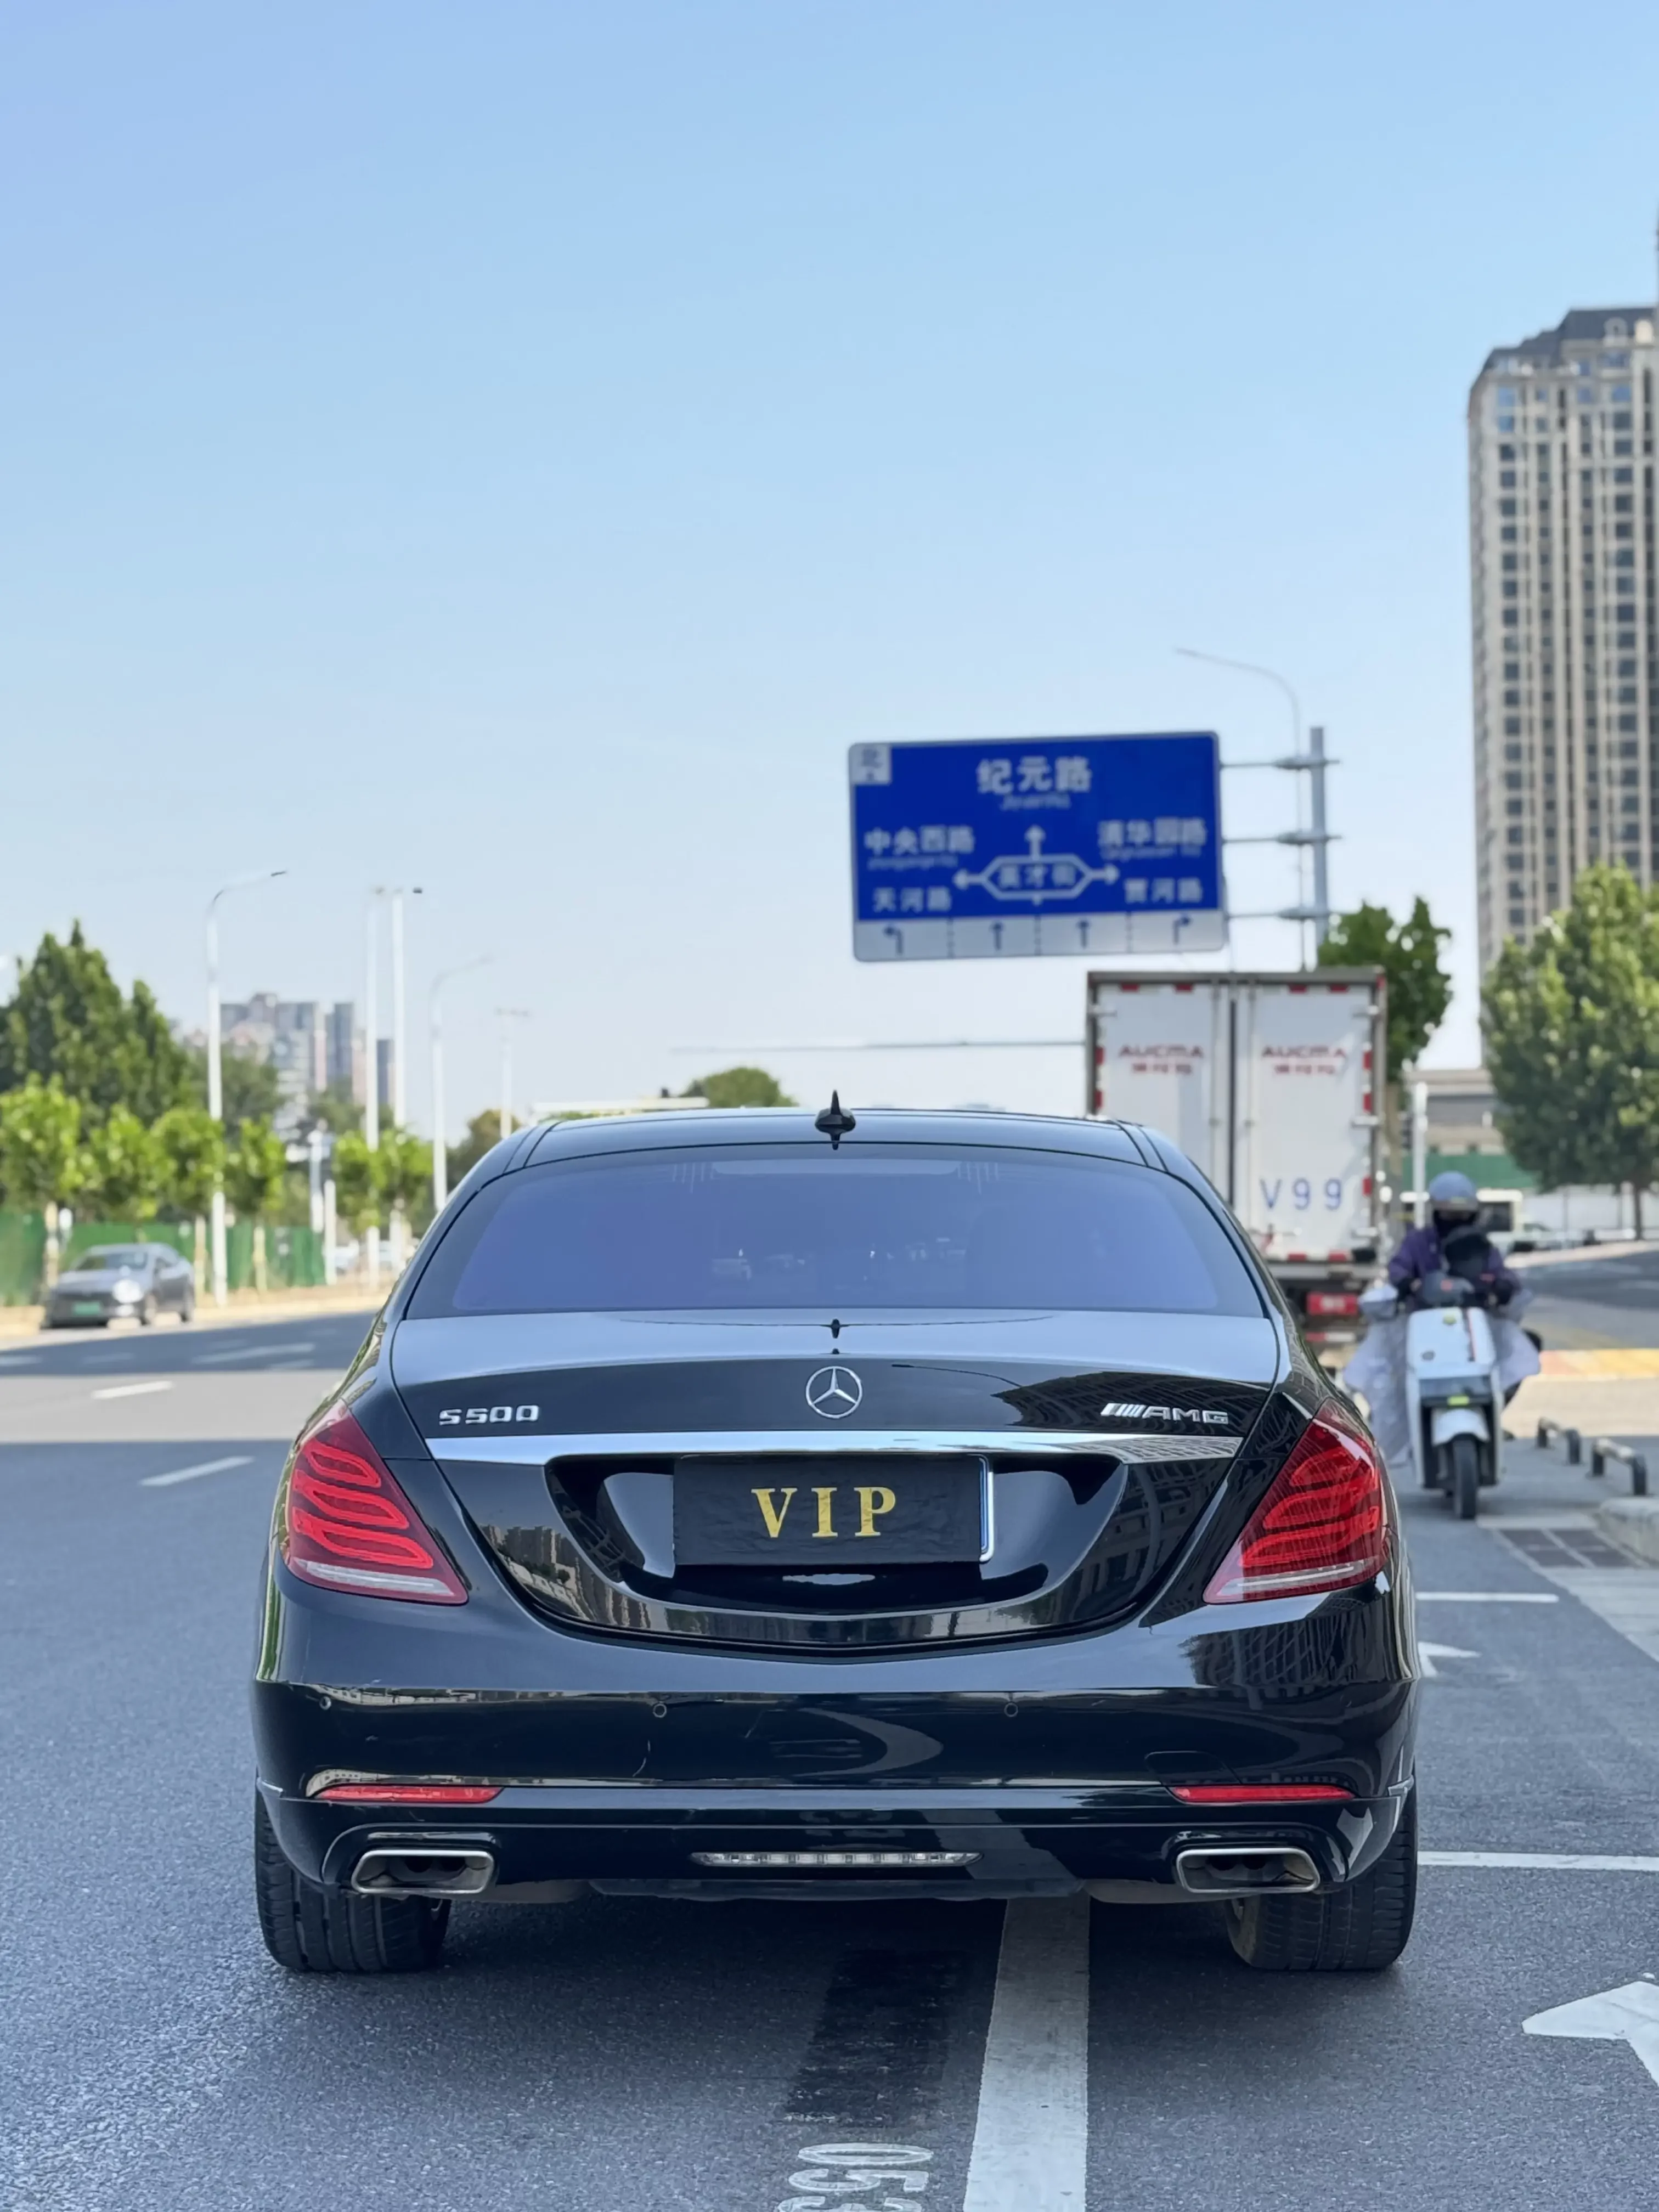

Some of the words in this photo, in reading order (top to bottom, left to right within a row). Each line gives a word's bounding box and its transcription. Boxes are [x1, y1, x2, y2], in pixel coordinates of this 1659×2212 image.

[977, 755, 1092, 793] 纪元路
[439, 1404, 540, 1426] S500
[751, 1487, 896, 1538] VIP
